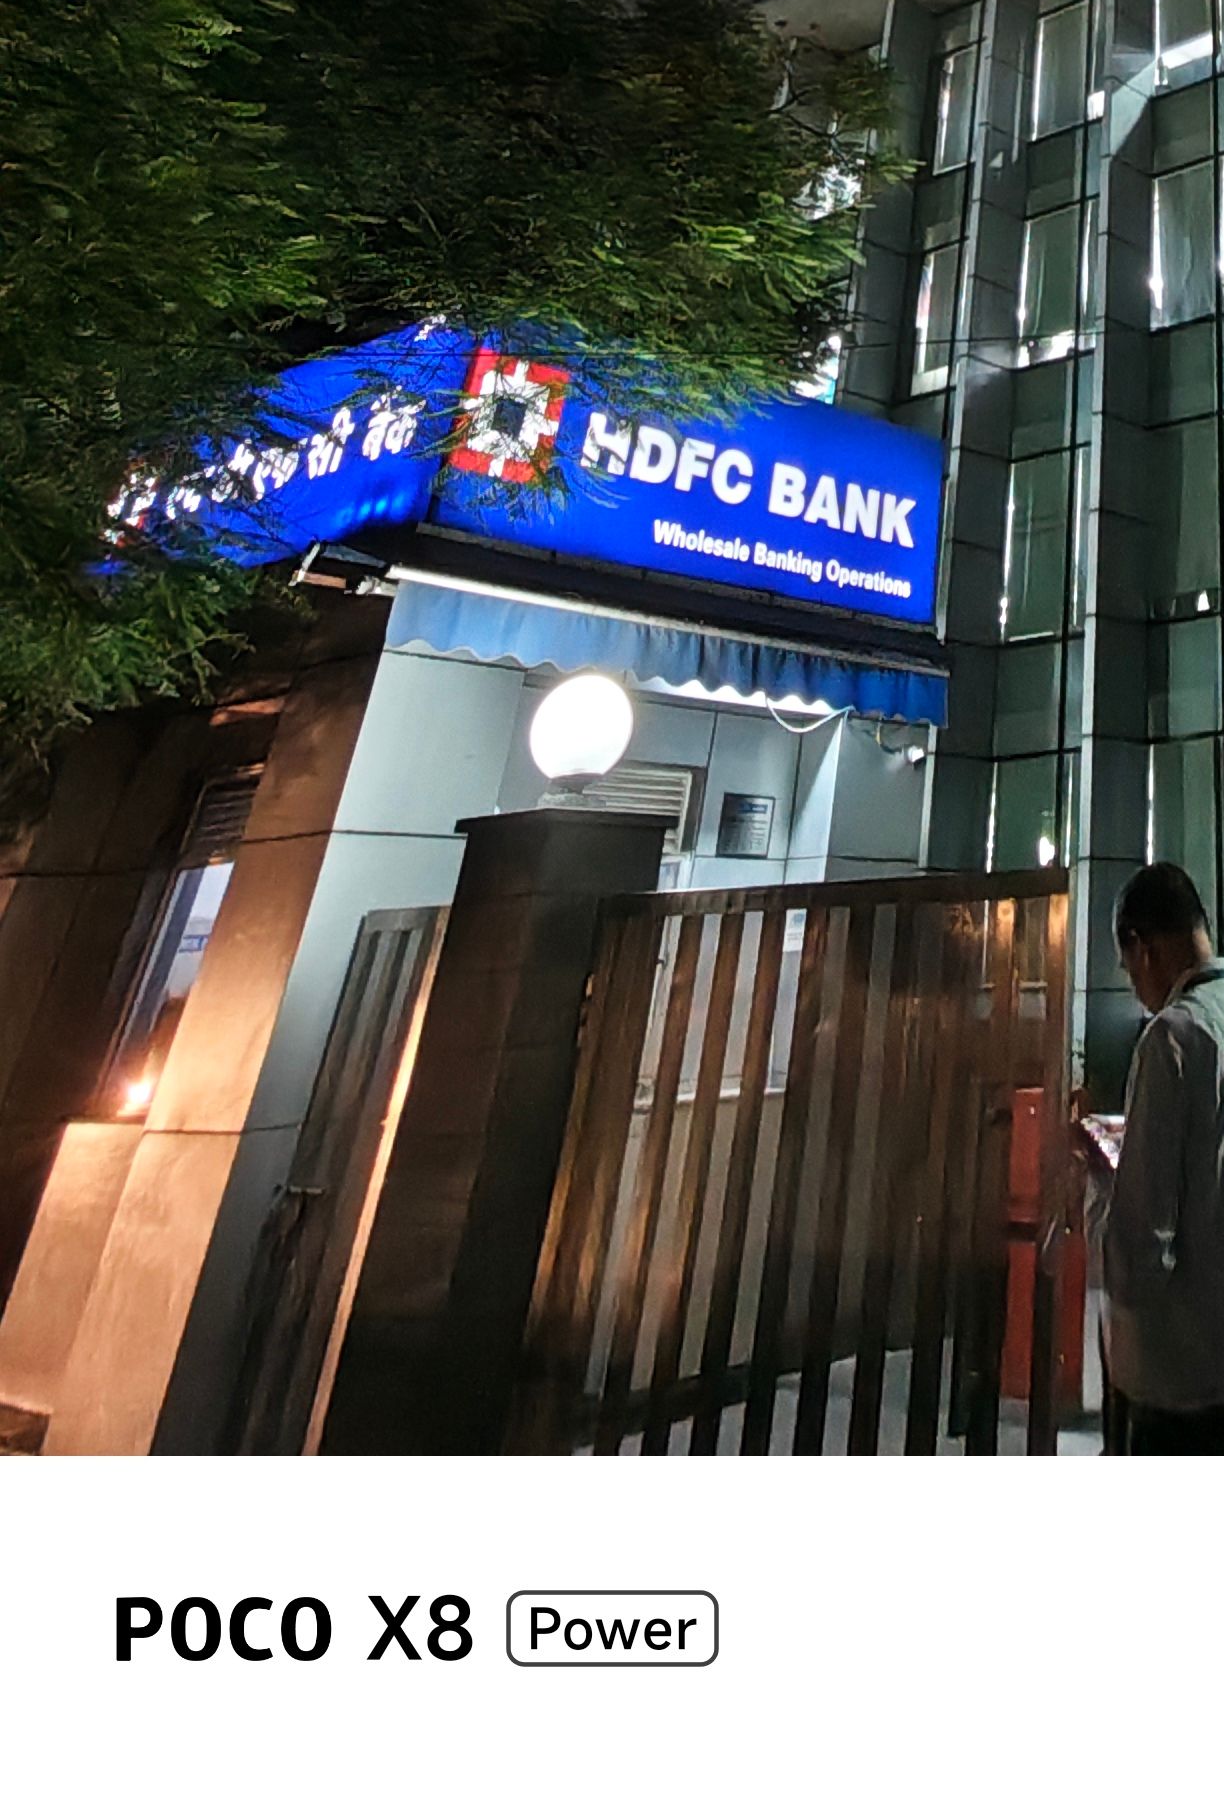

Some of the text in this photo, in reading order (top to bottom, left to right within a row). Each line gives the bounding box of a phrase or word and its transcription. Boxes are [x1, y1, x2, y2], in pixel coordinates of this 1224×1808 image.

[579, 411, 917, 549] HDFC BANK
[653, 519, 912, 599] Wholesale Banking Operations
